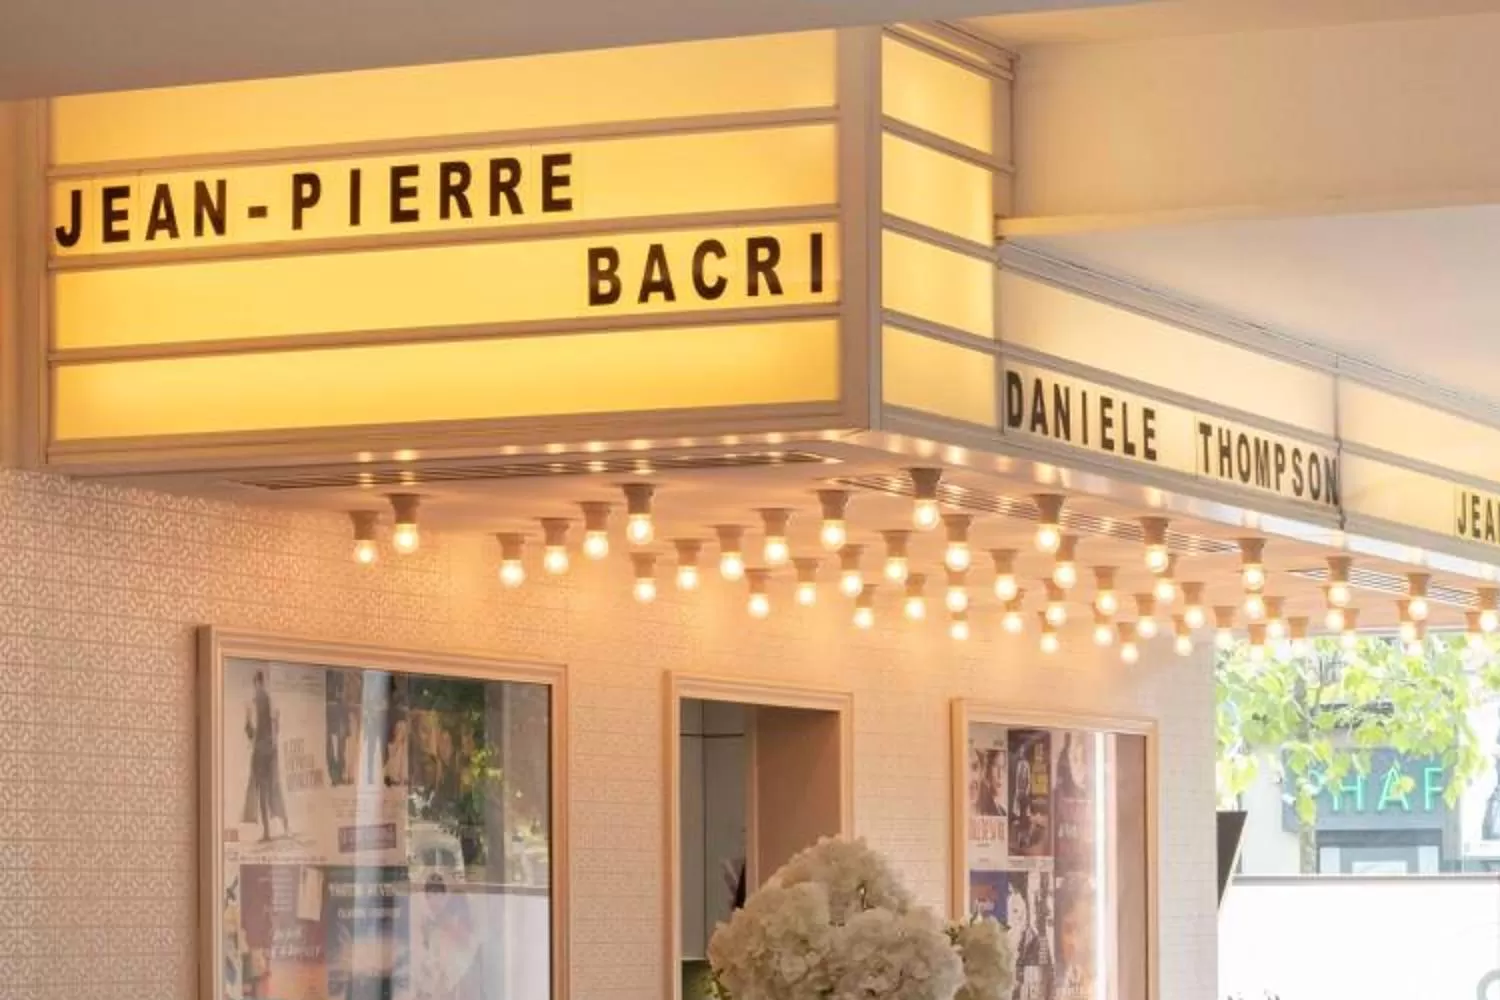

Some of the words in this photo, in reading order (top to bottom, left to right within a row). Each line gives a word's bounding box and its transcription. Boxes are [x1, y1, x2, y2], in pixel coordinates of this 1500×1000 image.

[55, 152, 574, 248] JEAN-PIERRE
[587, 232, 823, 307] BACRI
[1005, 369, 1158, 461] DANIELE
[1198, 421, 1340, 507] THOMPSON
